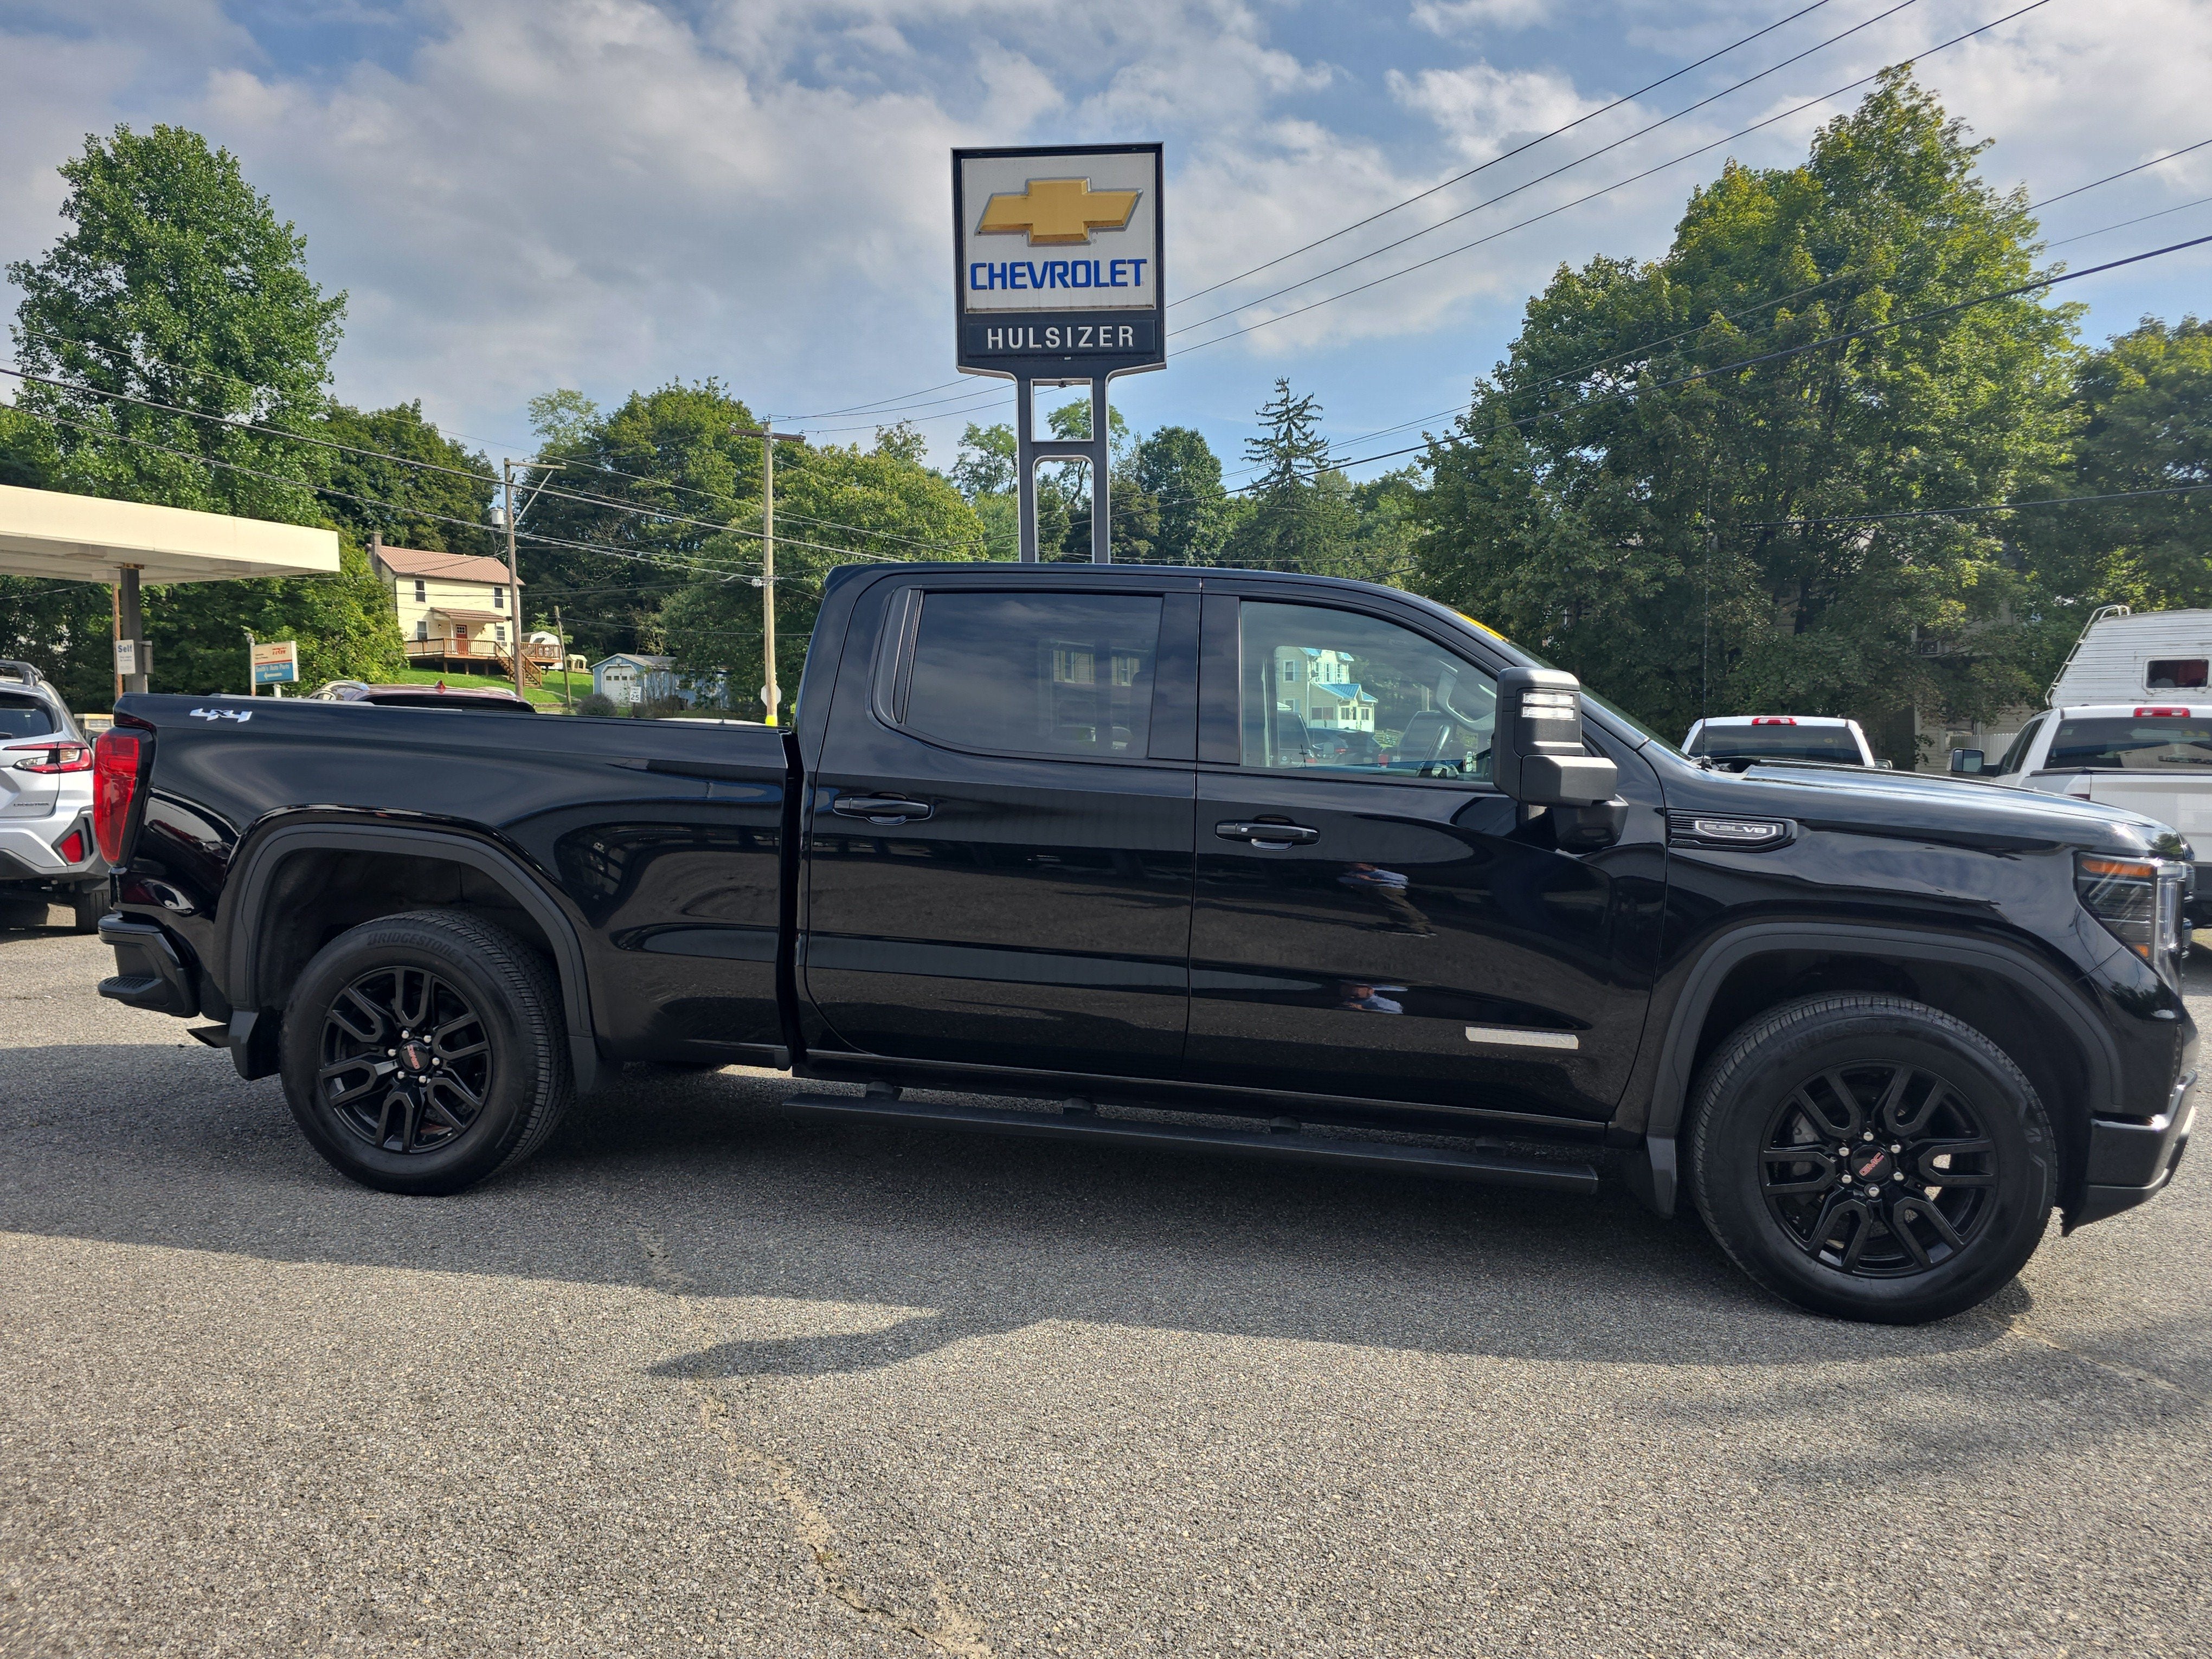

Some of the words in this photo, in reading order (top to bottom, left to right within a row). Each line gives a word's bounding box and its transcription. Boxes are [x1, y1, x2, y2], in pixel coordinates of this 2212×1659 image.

[970, 259, 1147, 290] CHEVROLET
[987, 326, 1133, 349] HULSIZER
[118, 644, 132, 653] Self
[367, 933, 460, 959] BRIDGESTONE
[1473, 1032, 1570, 1045] ELEVATION
[1859, 1152, 1884, 1176] GMC
